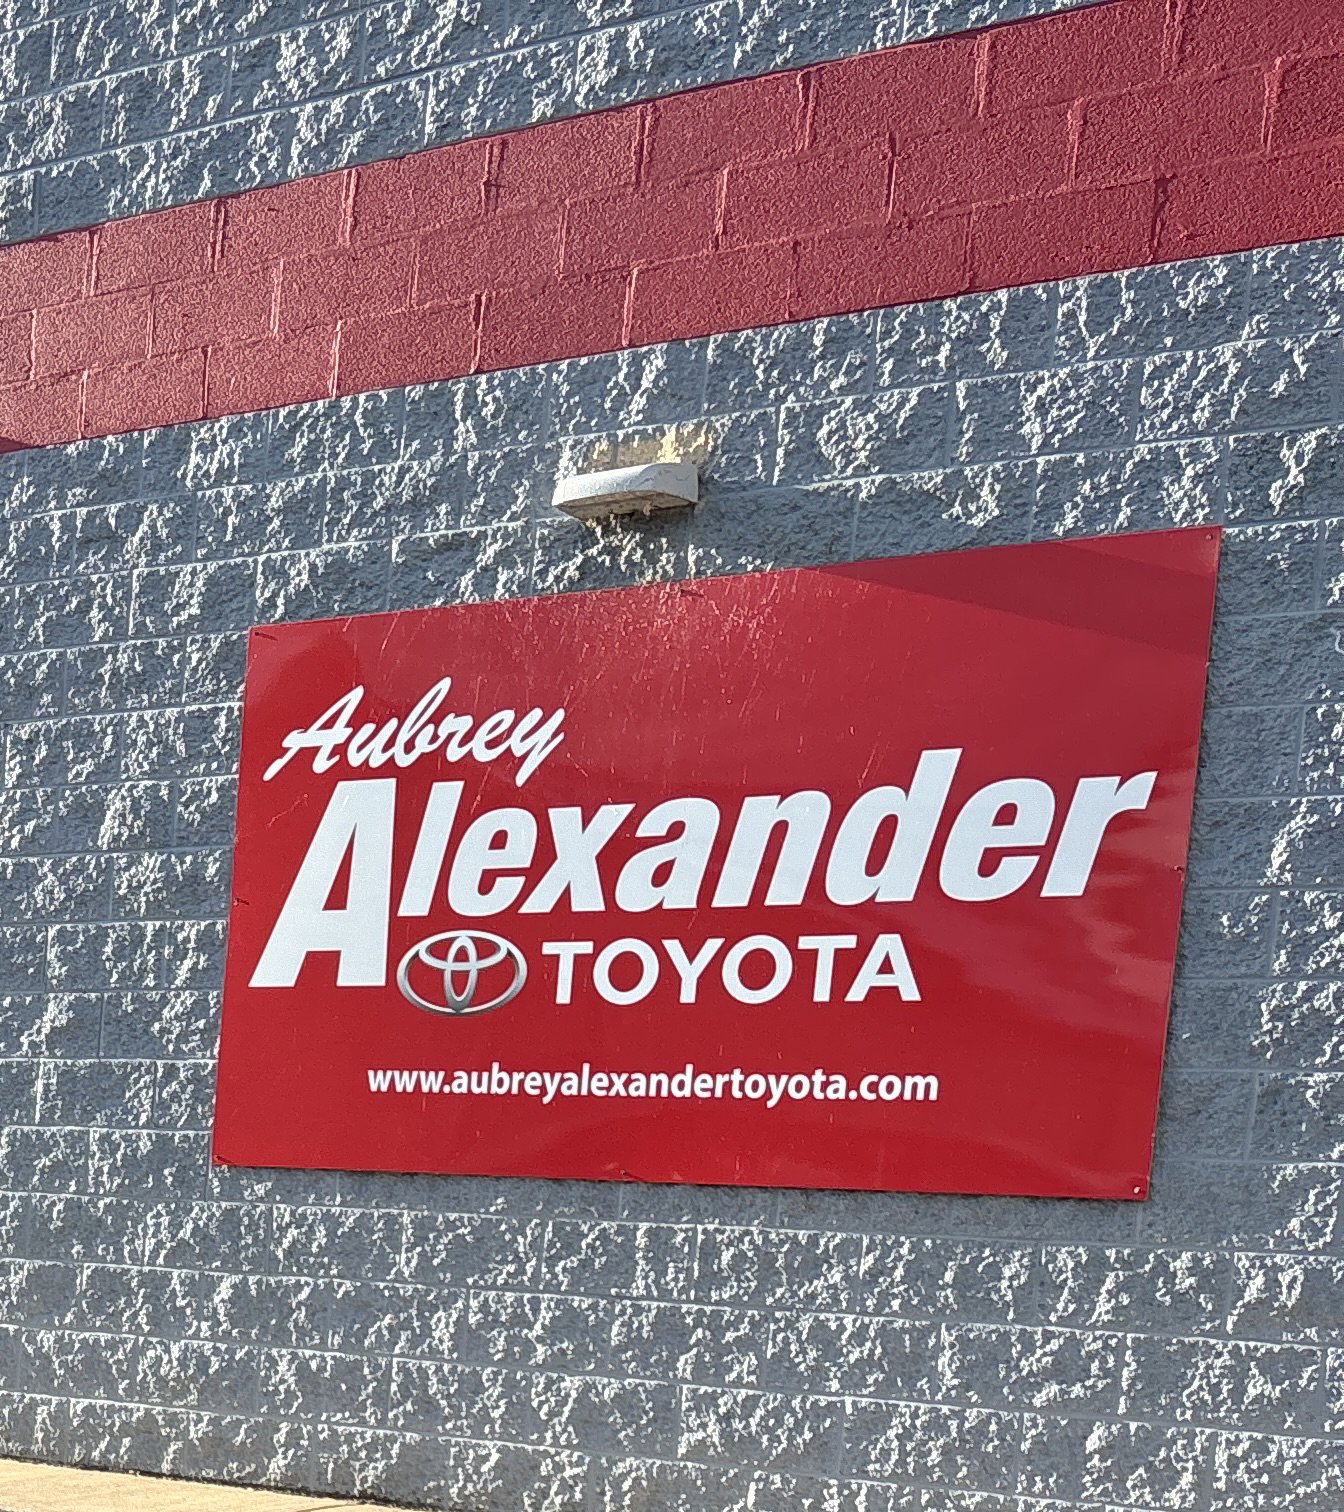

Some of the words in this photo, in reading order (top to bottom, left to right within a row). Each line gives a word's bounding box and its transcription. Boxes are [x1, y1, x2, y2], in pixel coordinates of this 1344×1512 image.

[263, 676, 566, 788] Aubrey
[247, 747, 1158, 988] Alexander
[541, 933, 922, 1006] TOYOTA
[367, 1061, 939, 1109] www.aubreyalexandertoyota.com
